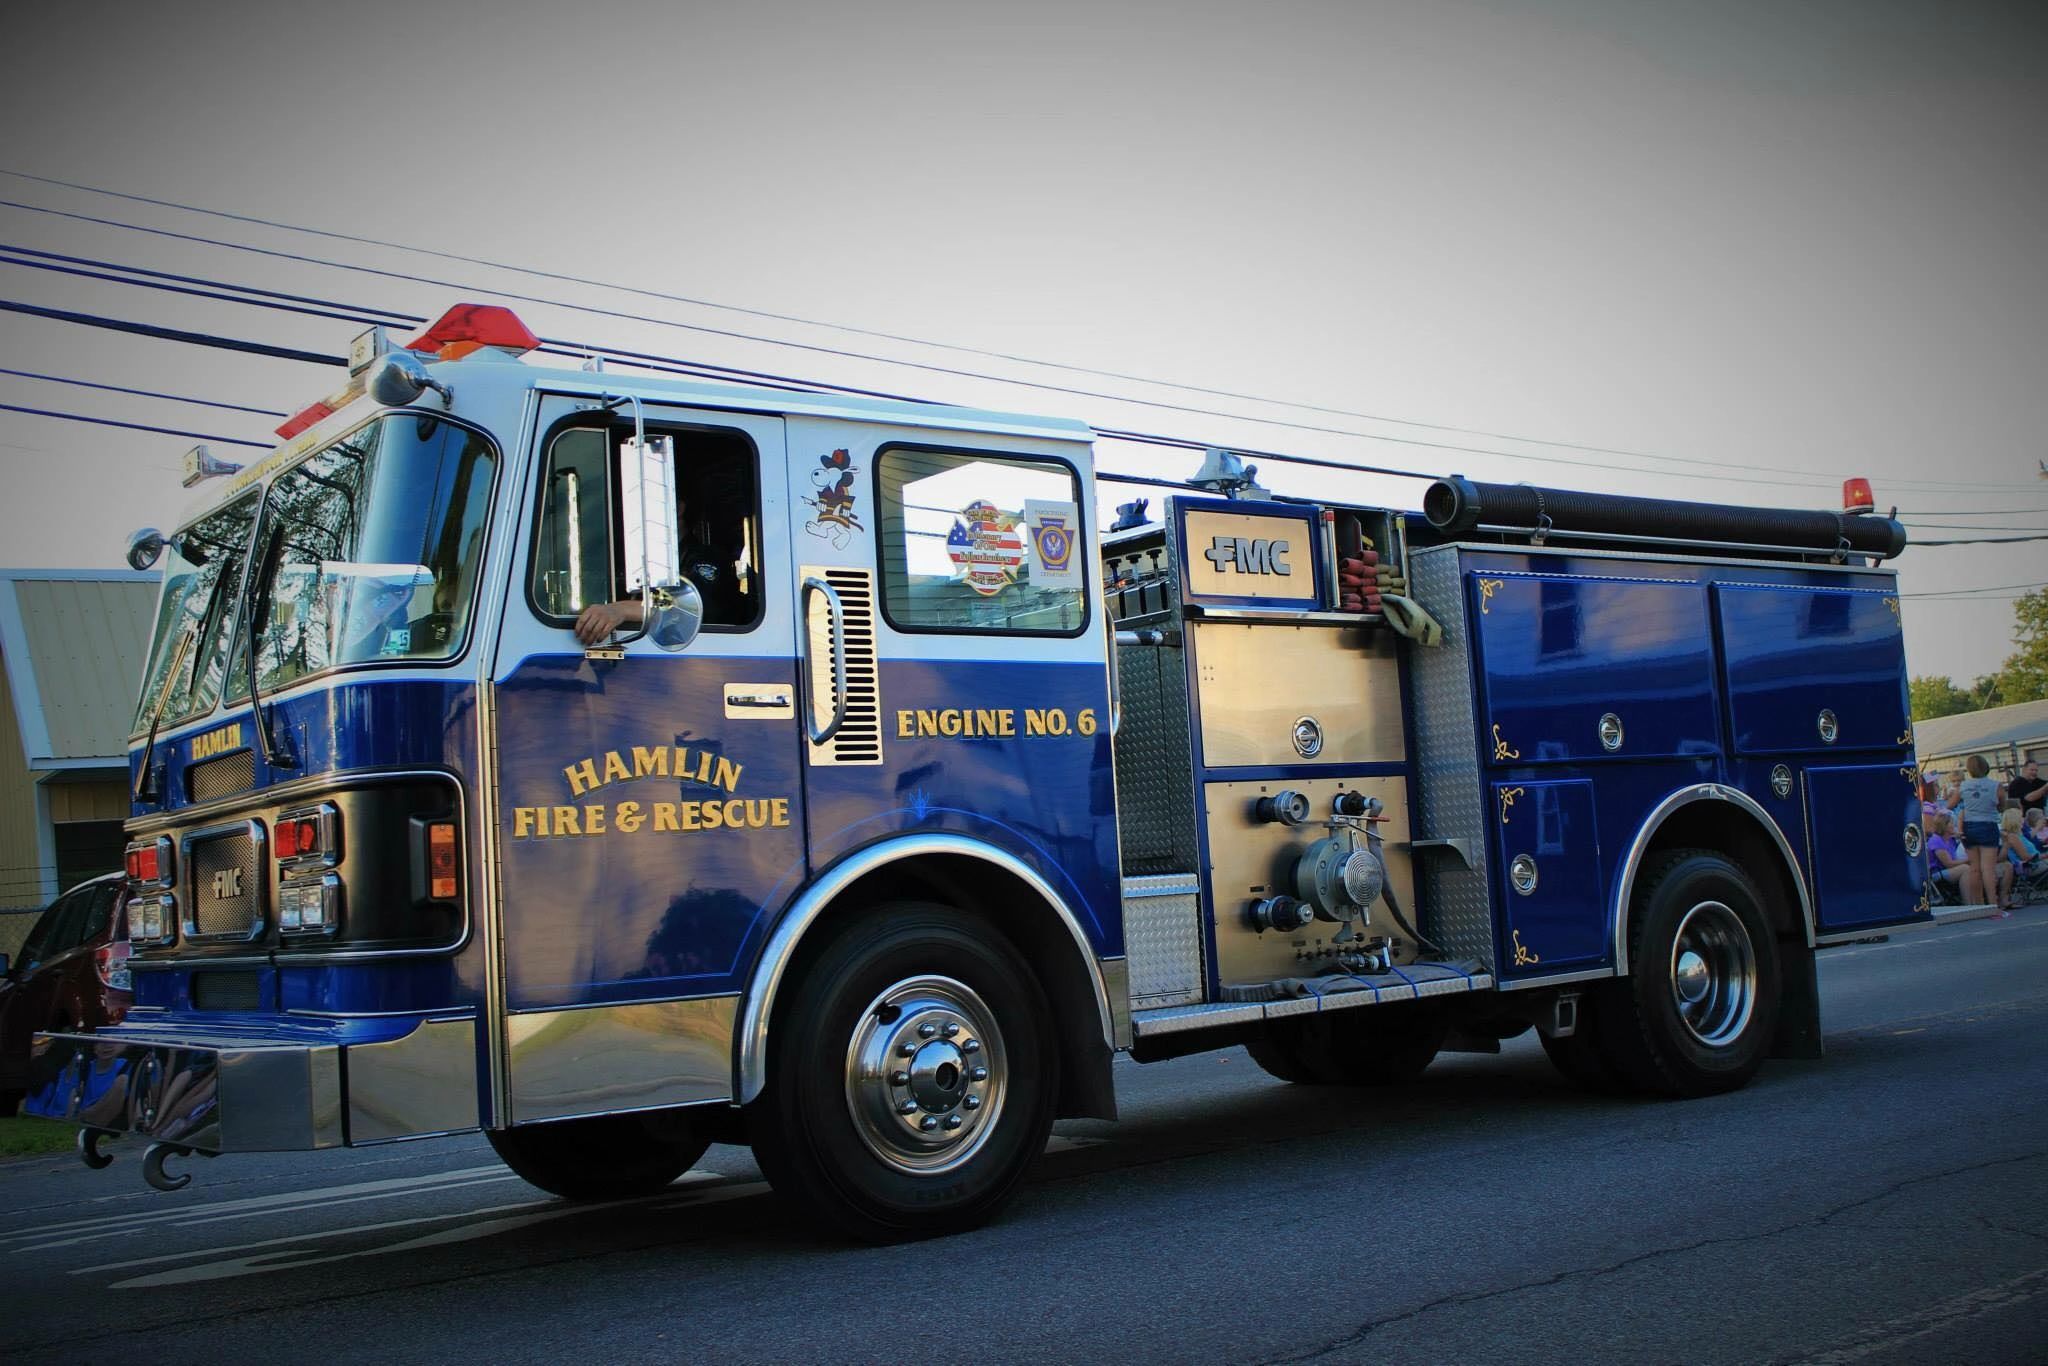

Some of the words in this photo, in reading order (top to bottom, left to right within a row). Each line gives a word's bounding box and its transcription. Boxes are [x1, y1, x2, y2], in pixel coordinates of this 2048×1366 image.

[1204, 536, 1290, 576] FMC
[897, 709, 1016, 737] ENGINE
[1024, 709, 1073, 736] NO.
[1077, 708, 1097, 736] 6
[192, 723, 241, 761] HAMLIN
[563, 746, 743, 797] HAMLIN
[513, 805, 607, 837] FIRE
[615, 801, 647, 834] &
[653, 798, 790, 832] RESCUE
[211, 867, 241, 899] FMC
